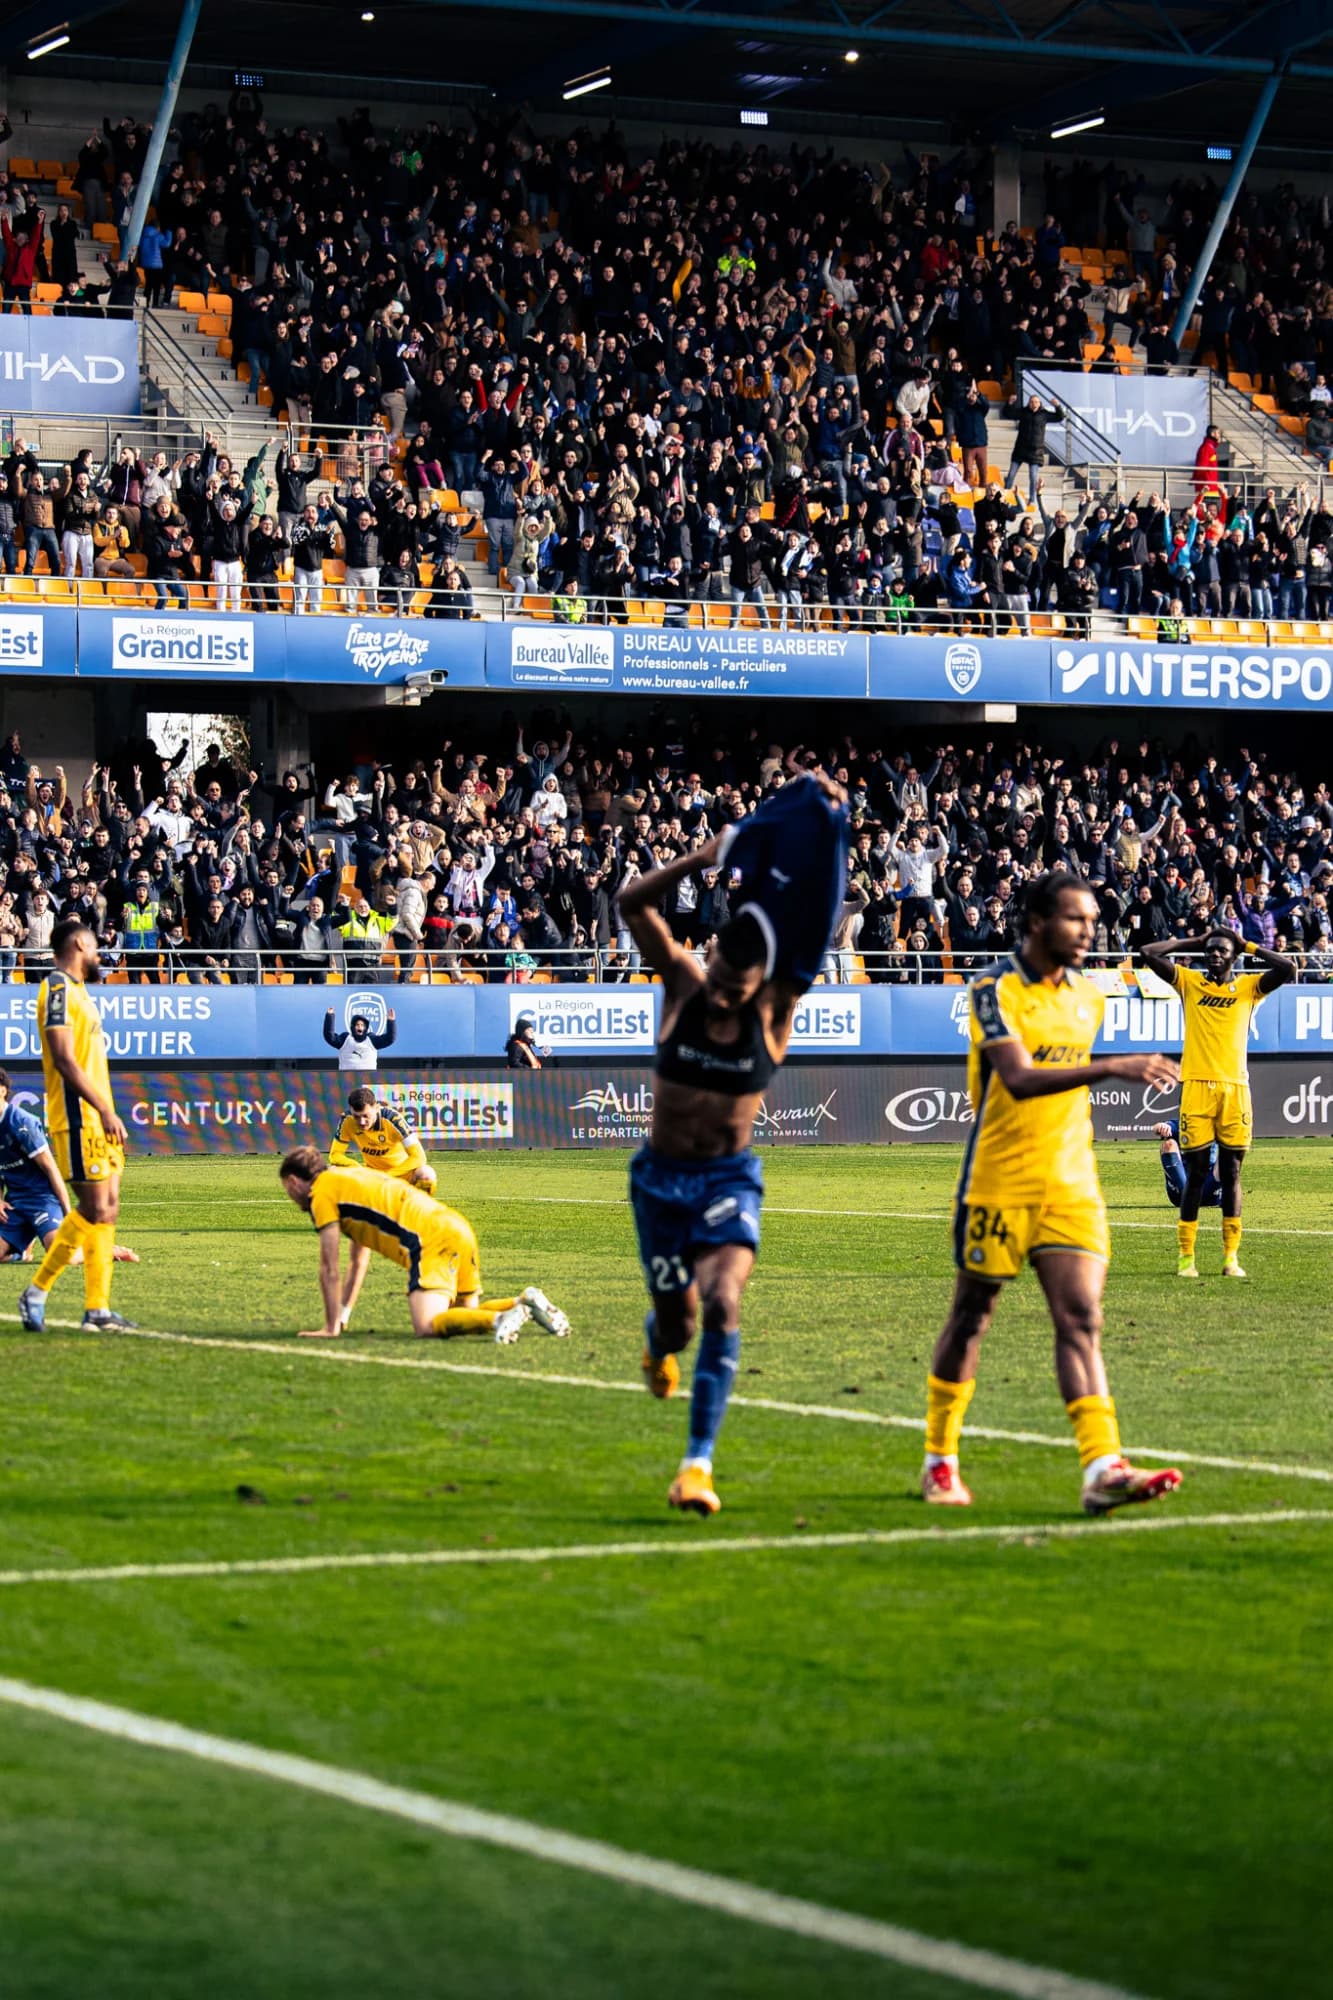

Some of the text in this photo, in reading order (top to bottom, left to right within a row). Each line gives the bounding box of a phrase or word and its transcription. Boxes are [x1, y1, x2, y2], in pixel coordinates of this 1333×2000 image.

[0, 351, 125, 384] IHAD
[140, 624, 195, 638] La Région
[517, 642, 609, 665] Bureau Vallée
[623, 634, 848, 657] BUREAU VALLEE BARBEREY
[623, 656, 709, 671] Professionnels
[721, 658, 787, 672] Particuliers
[622, 675, 749, 690] www.bureau-vallee.fr
[1105, 651, 1333, 701] INTERSPO
[90, 996, 212, 1020] MEURES
[538, 1000, 594, 1012] La Région
[1197, 995, 1237, 1009] HOLY
[815, 1008, 856, 1034] Est
[102, 1031, 196, 1055] OUTIER
[391, 1090, 450, 1103] La Région
[600, 1082, 655, 1112] Aub
[1088, 1091, 1131, 1105] AISON
[131, 1100, 274, 1125] CENTURY
[597, 1114, 610, 1123] en
[572, 1128, 585, 1139] LE
[768, 1129, 819, 1137] CHAMPAGNE
[970, 1206, 1008, 1245] 34
